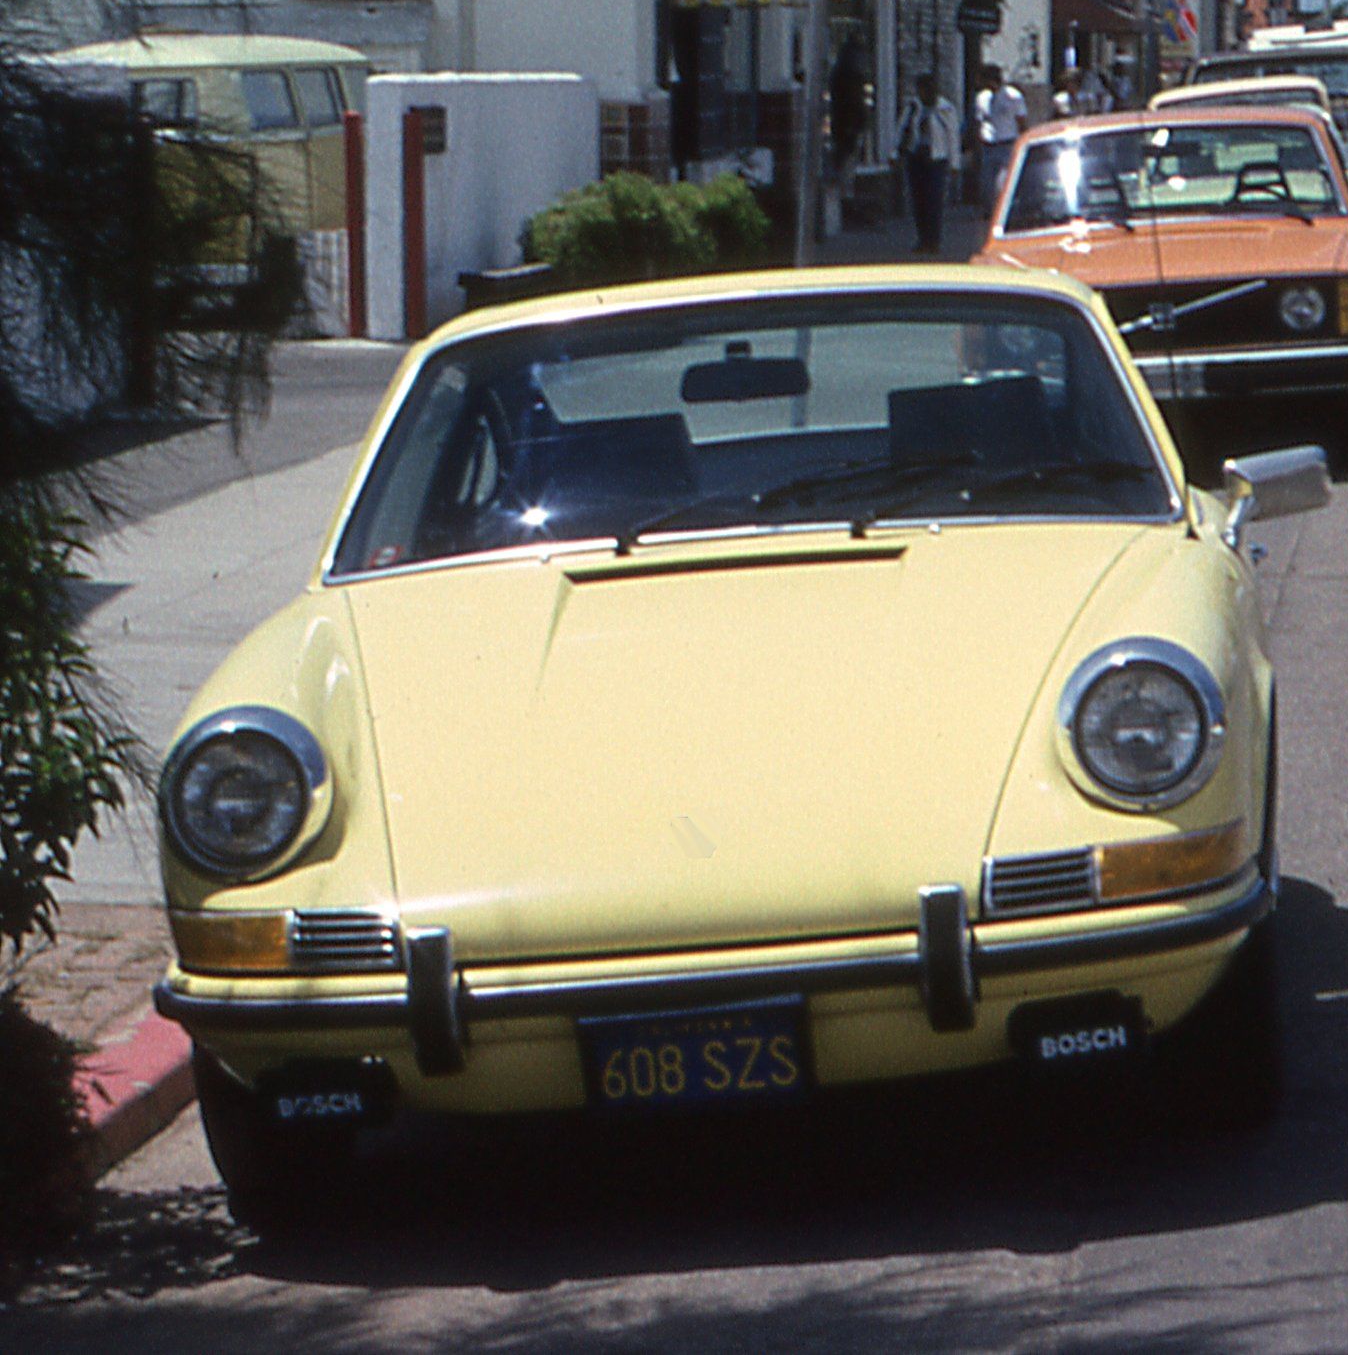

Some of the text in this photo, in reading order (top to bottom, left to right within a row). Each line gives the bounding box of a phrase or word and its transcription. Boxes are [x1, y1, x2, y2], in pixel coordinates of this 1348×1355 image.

[1041, 1026, 1127, 1059] BOSCH
[602, 1034, 798, 1099] 608 SZS
[278, 1092, 363, 1117] BOSCH
